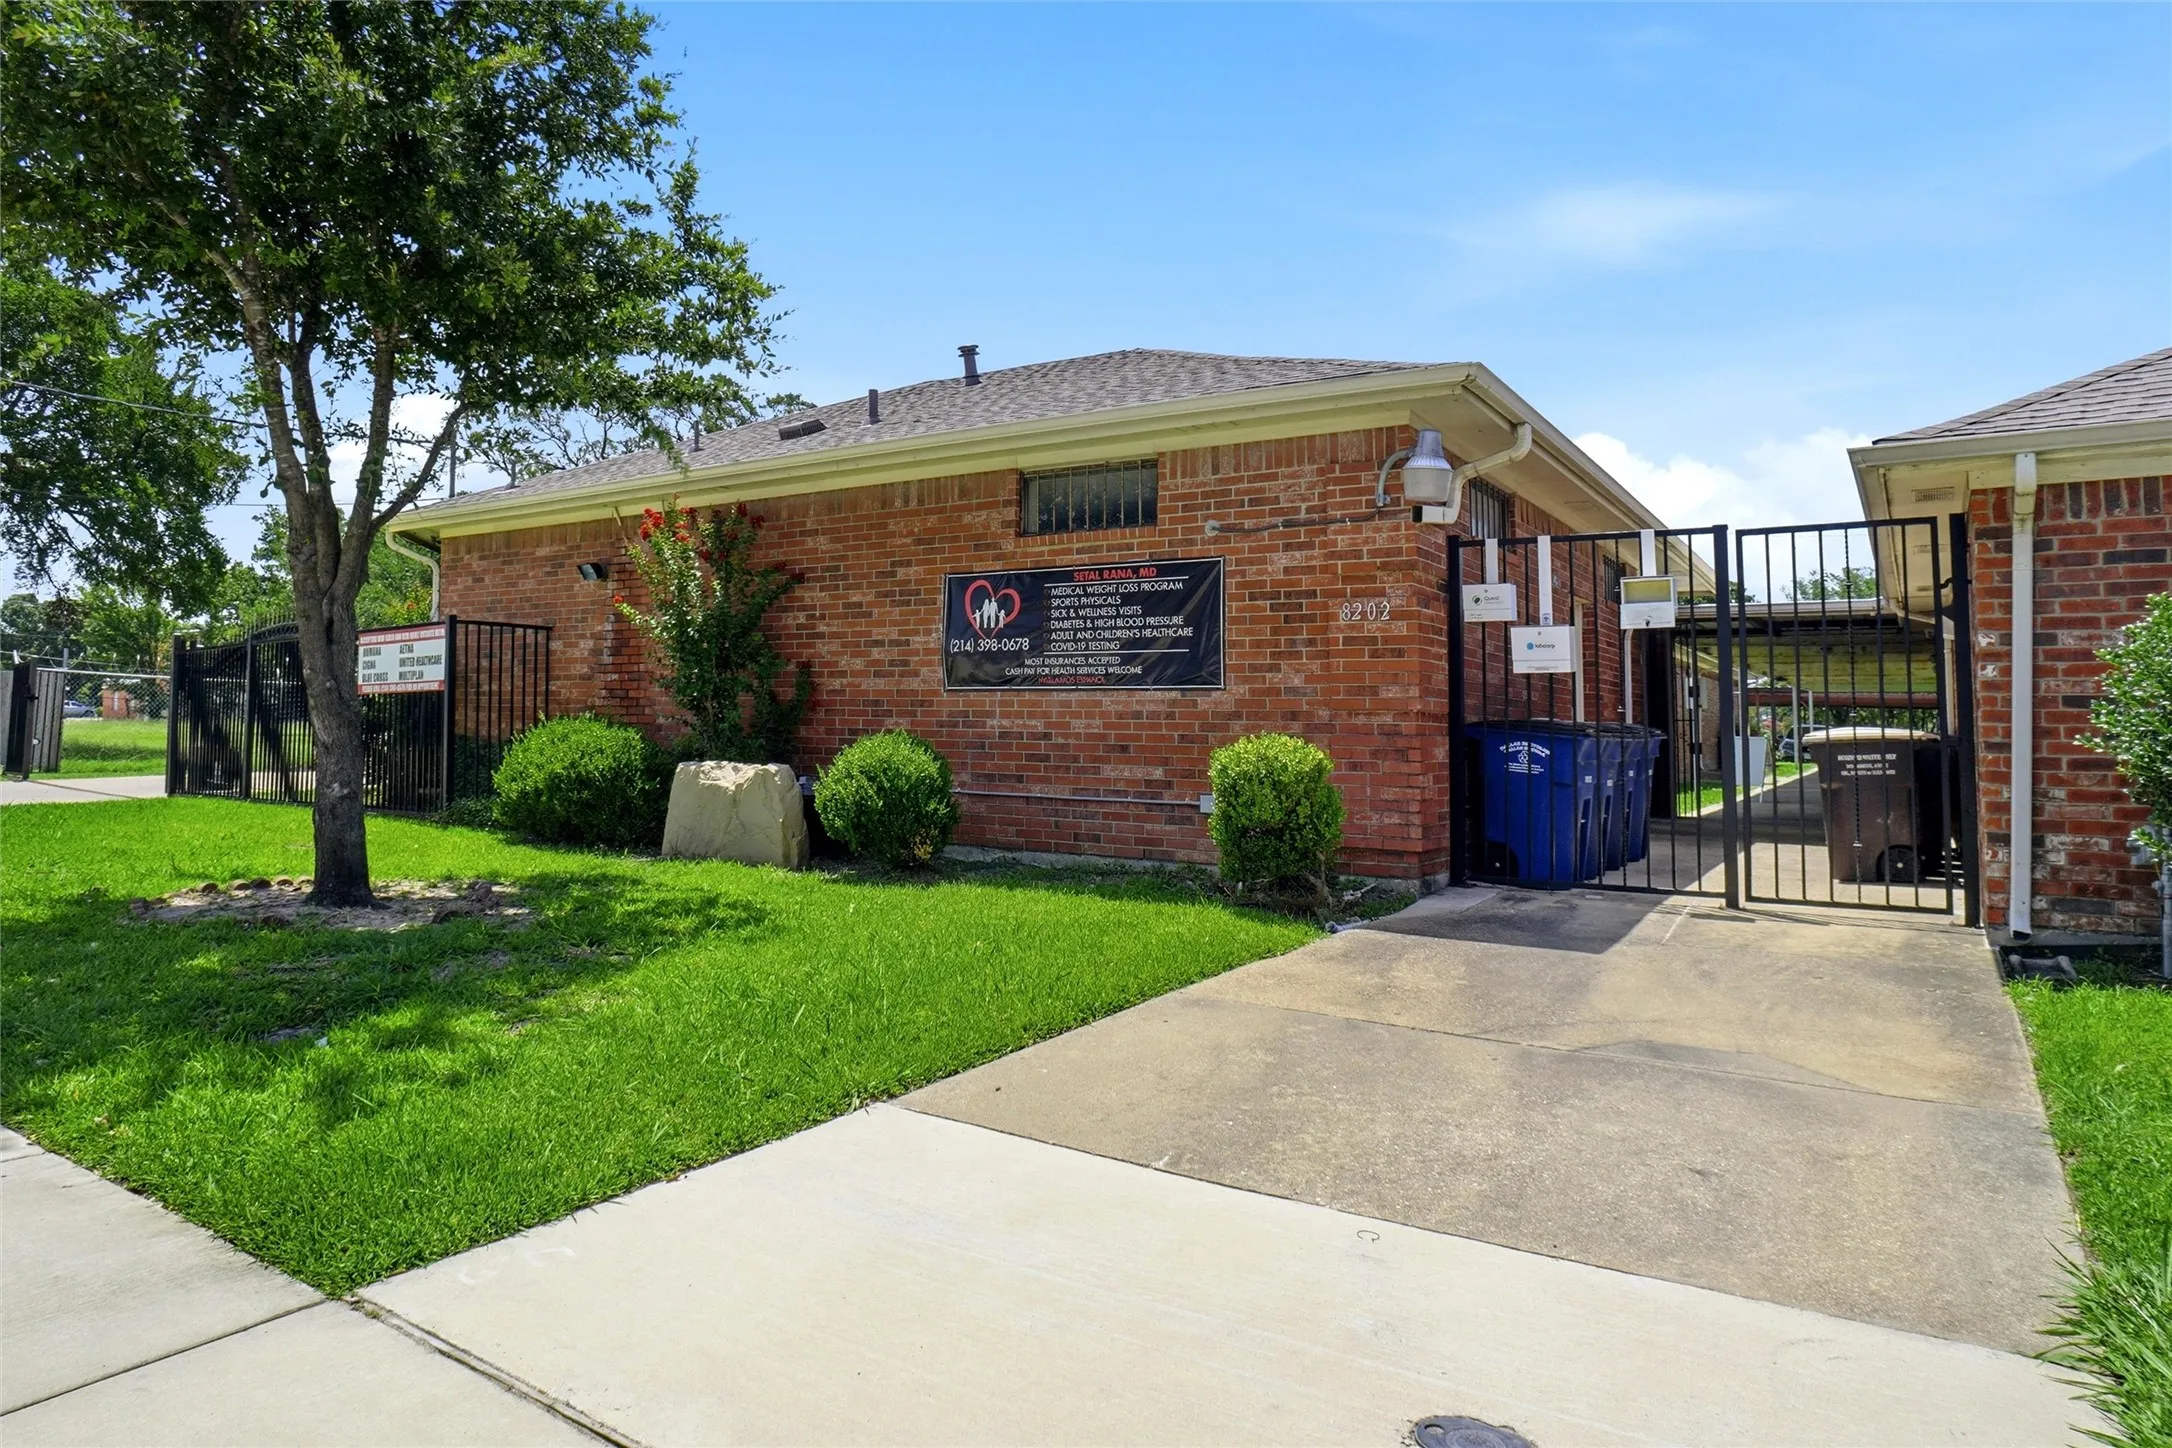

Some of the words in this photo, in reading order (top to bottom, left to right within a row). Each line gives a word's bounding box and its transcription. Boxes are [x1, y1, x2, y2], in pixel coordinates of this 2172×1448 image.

[1073, 571, 1101, 582] SETAL
[1103, 568, 1136, 580] RANA,
[1139, 567, 1157, 578] MD
[1051, 586, 1084, 596] MEDICAL
[1086, 584, 1117, 594] WEIGHT
[1118, 583, 1139, 593] LOSS
[1140, 581, 1183, 592] PROGRAM
[1051, 598, 1079, 607] SPORTS
[1081, 595, 1121, 605] PHYSICALS
[1051, 609, 1068, 618] SICK
[1069, 608, 1076, 617] &
[1078, 607, 1117, 616] WELLNESS
[1118, 605, 1142, 615] VISITS
[1342, 602, 1390, 620] 8202
[1051, 620, 1085, 629] DIABETES
[1086, 618, 1093, 628] &
[1094, 618, 1115, 627] HIGH
[1116, 617, 1145, 627] BLOOD
[1146, 615, 1184, 626] PRESSURE
[1050, 631, 1074, 640] ADULT
[1076, 630, 1095, 639] AND
[1095, 628, 1140, 639] CHILDREN'S
[1141, 627, 1193, 638] HEALTHCARE
[950, 637, 974, 653] (214)
[977, 637, 1030, 651] 398-0678
[1050, 642, 1087, 651] COVID-19
[1088, 641, 1120, 650] TESTING
[416, 655, 443, 666] HEALTHCARE
[1024, 658, 1043, 666] MOST
[1044, 657, 1086, 665] INSURANCES
[1087, 656, 1121, 665] ACCEPTED
[1005, 667, 1023, 675] CASH
[1036, 667, 1050, 675] FOR
[1051, 667, 1075, 675] HEALTH
[1076, 666, 1106, 675] SERVICES
[1107, 665, 1143, 674] WELCOME
